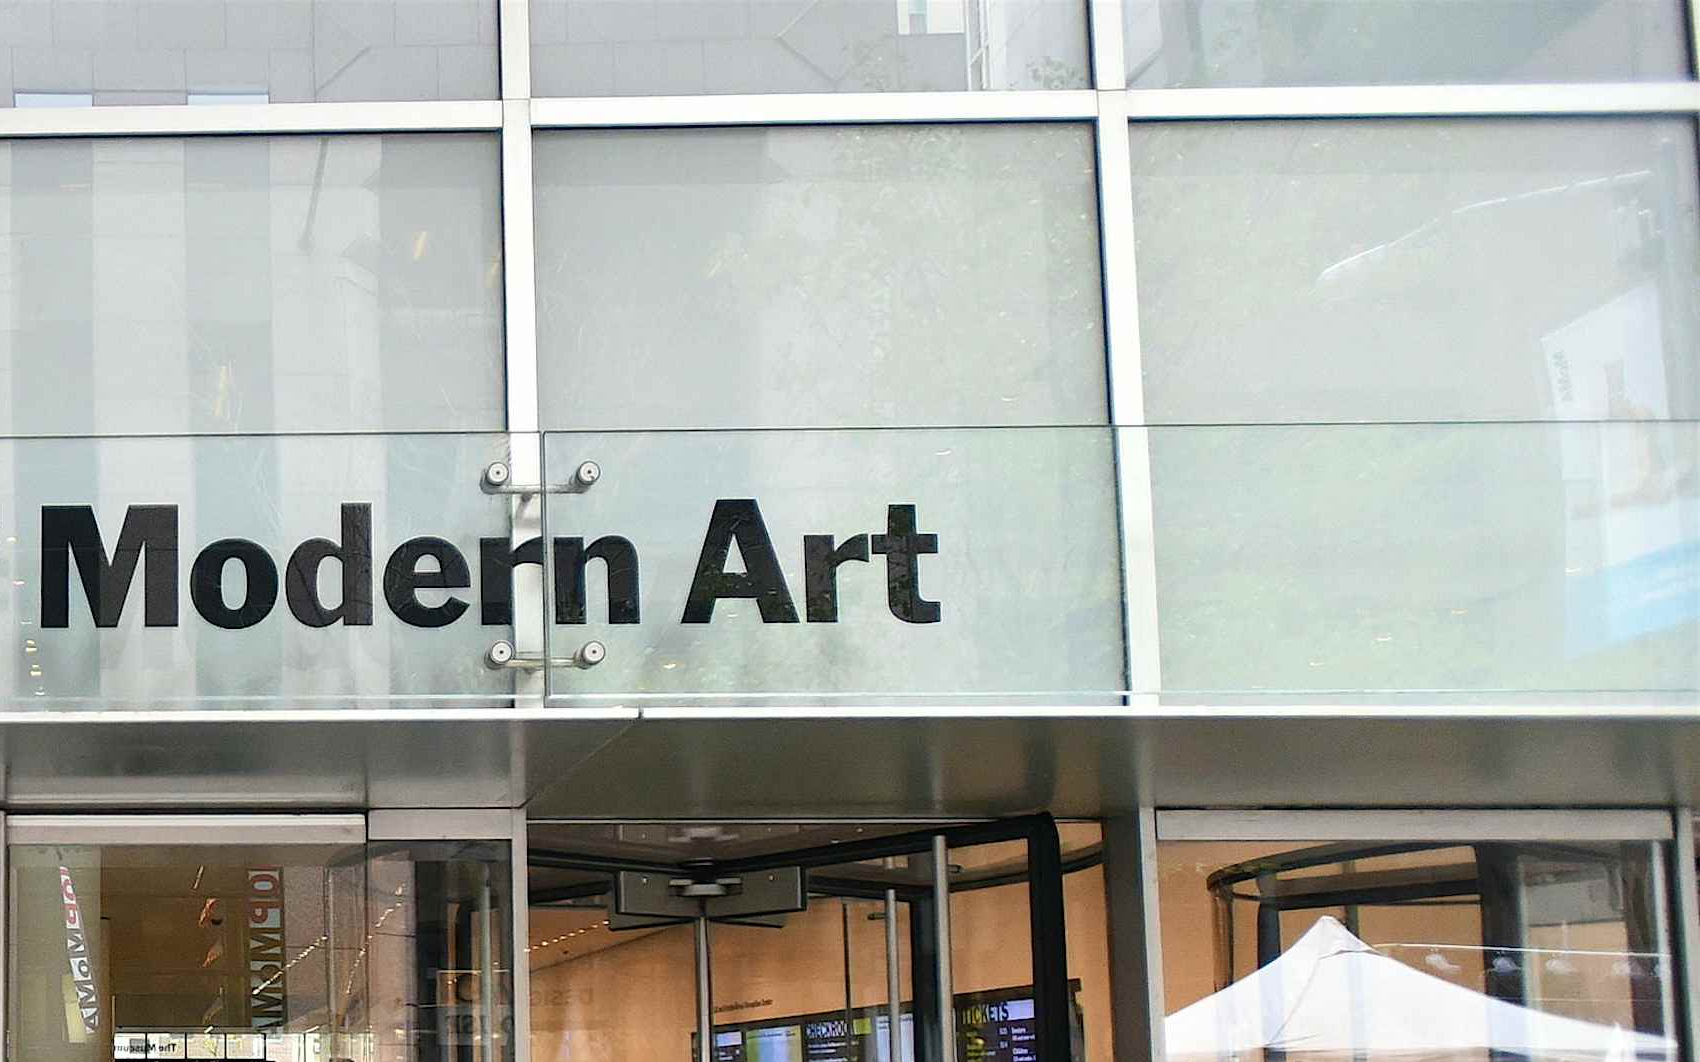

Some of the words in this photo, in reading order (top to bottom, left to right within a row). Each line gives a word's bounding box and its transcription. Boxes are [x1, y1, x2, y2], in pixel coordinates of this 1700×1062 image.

[41, 503, 640, 630] Modern
[681, 499, 941, 624] Art
[961, 1000, 1009, 1024] TICKETS
